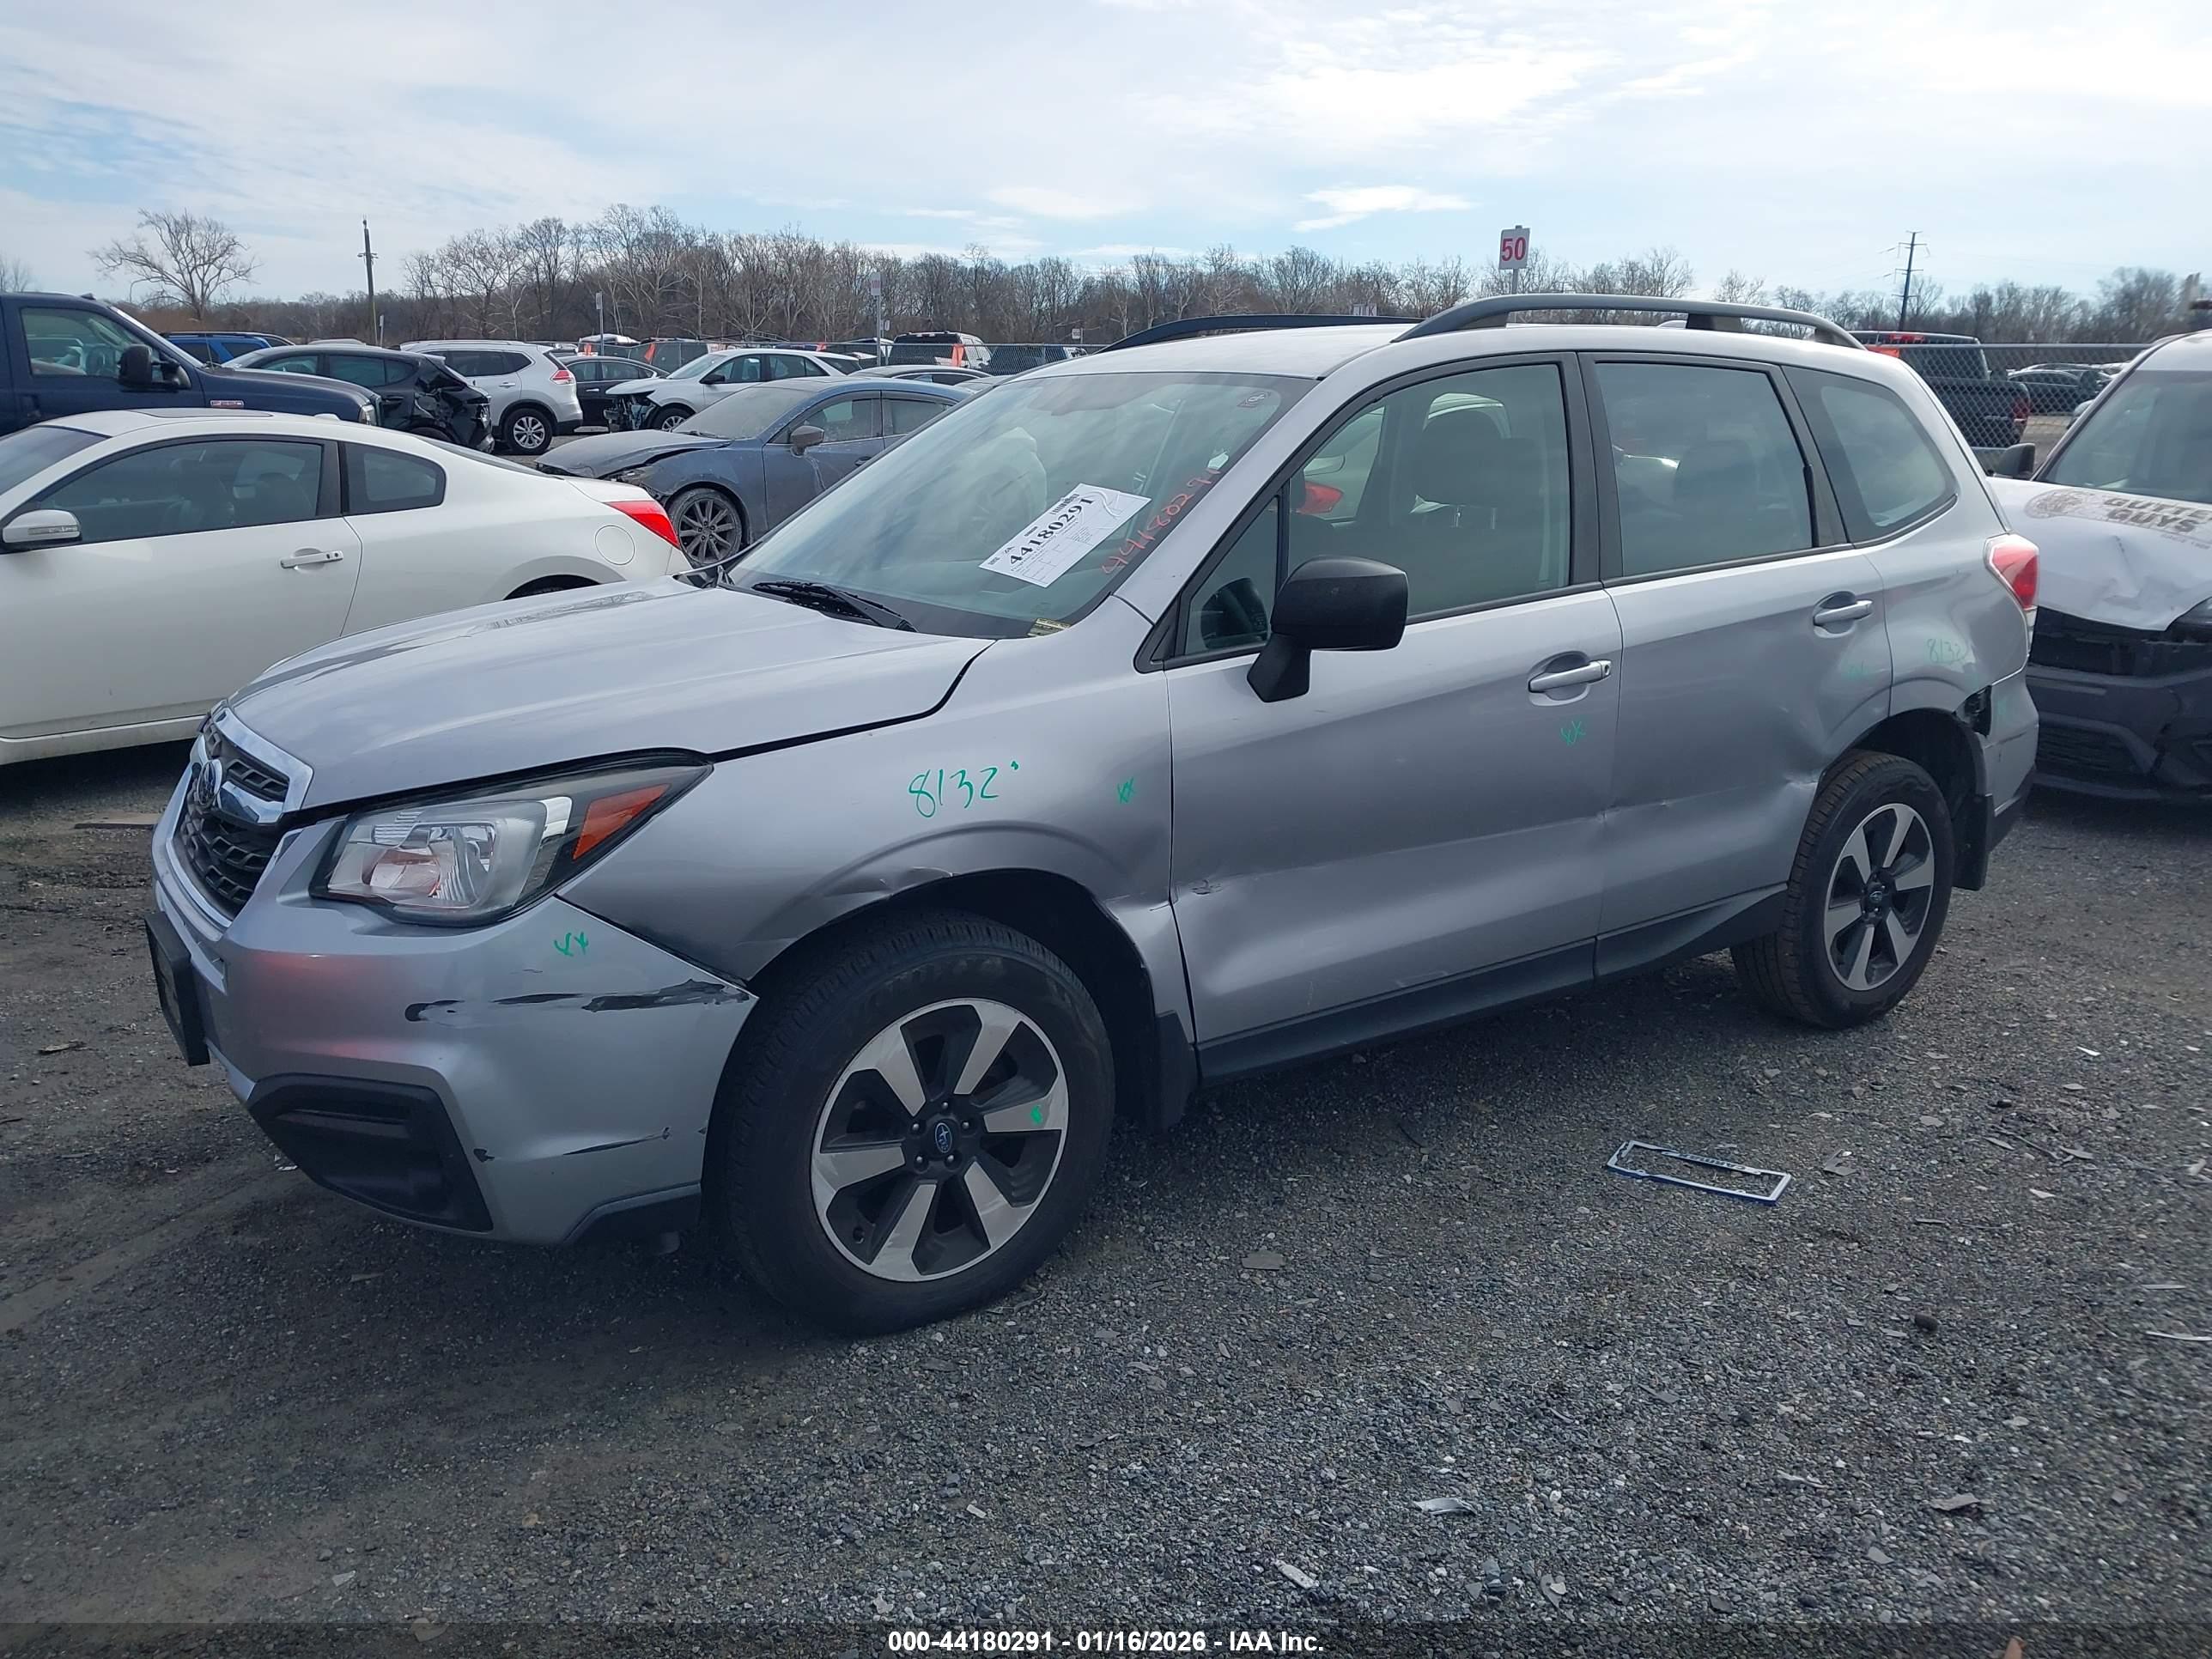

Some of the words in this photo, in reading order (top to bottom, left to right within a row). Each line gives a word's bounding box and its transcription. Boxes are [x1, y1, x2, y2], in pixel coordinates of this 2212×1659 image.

[1502, 237, 1526, 261] 50
[1010, 497, 1094, 566] 44180291
[2107, 508, 2198, 533] GUYS
[1927, 638, 1966, 663] 8132
[908, 767, 1000, 817] 8132
